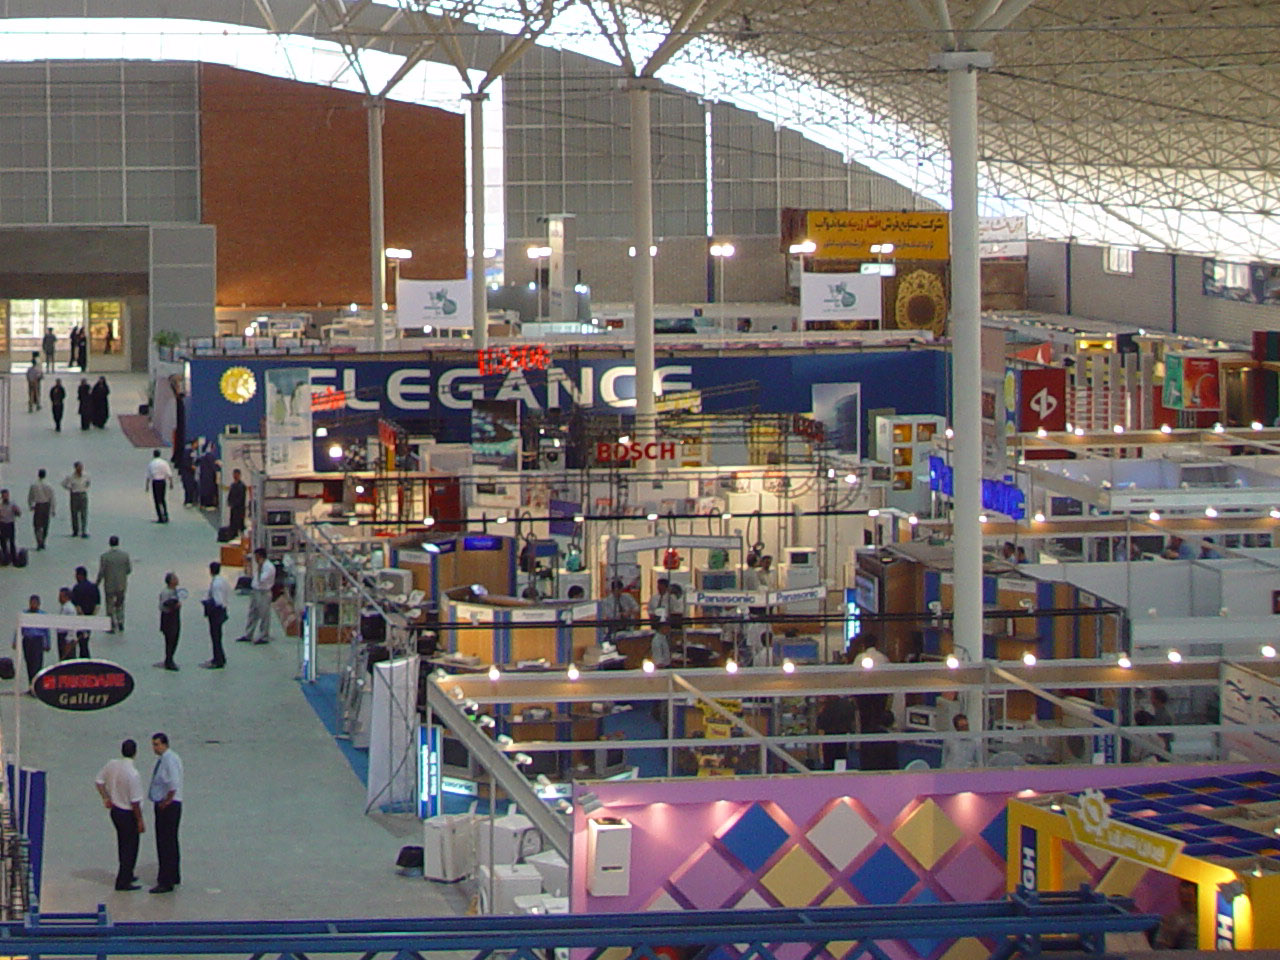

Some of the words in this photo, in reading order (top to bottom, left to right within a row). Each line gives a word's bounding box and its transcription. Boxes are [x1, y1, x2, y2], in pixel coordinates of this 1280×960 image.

[596, 442, 676, 462] BOSCH
[697, 593, 755, 604] Panasonic
[776, 590, 819, 602] Panasonic
[59, 692, 110, 706] Gallery
